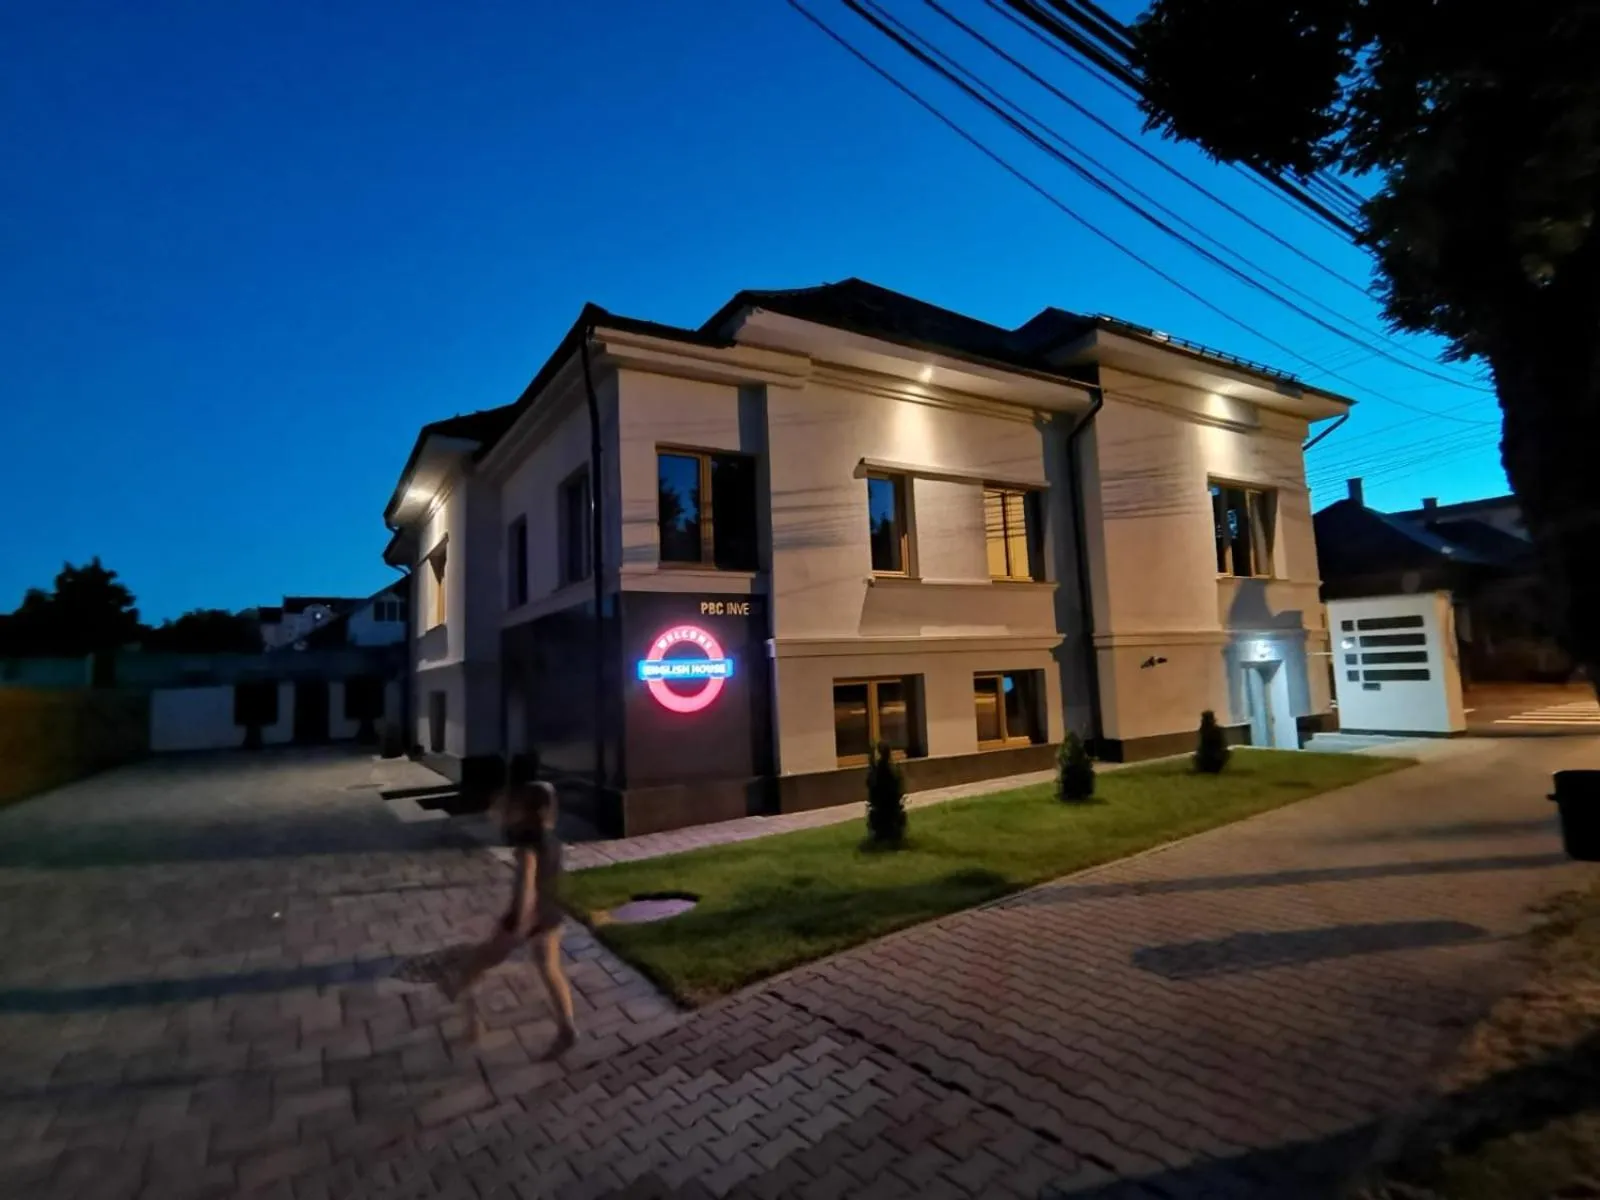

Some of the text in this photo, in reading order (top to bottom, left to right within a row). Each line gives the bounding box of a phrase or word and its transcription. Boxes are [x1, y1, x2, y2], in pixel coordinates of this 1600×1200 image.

[701, 602, 724, 615] PBC
[657, 631, 713, 648] WELCOME
[644, 664, 727, 675] ENGLISH HOUSE
